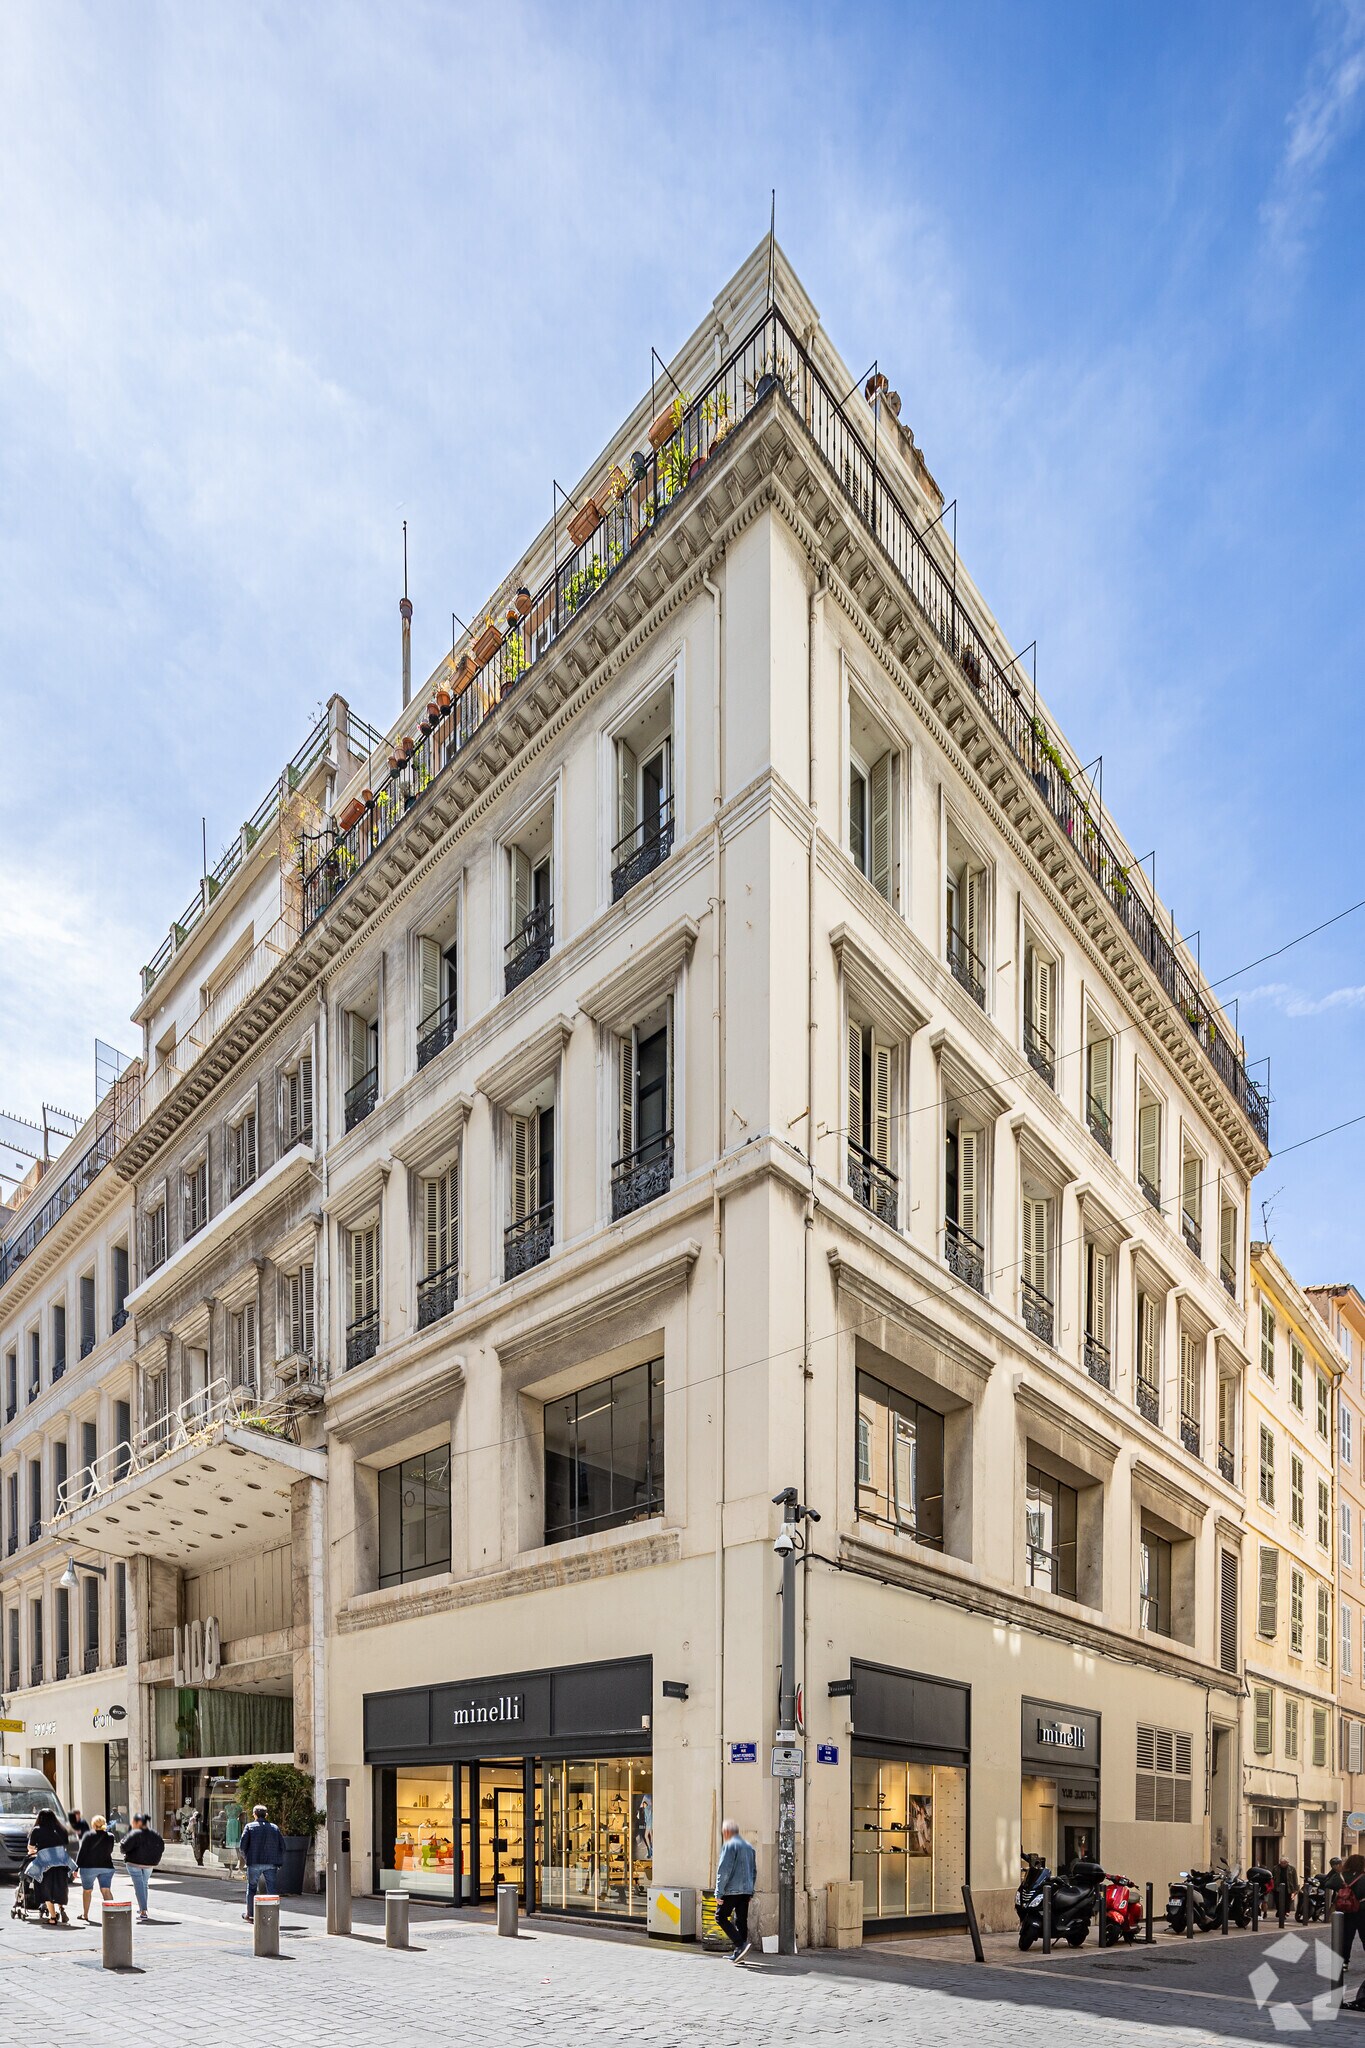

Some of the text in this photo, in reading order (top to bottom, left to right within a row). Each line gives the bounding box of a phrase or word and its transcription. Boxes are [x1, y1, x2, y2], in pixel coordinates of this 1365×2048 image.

[173, 1616, 220, 1687] LIDO
[453, 1696, 519, 1725] minelli
[1042, 1723, 1086, 1748] minelli
